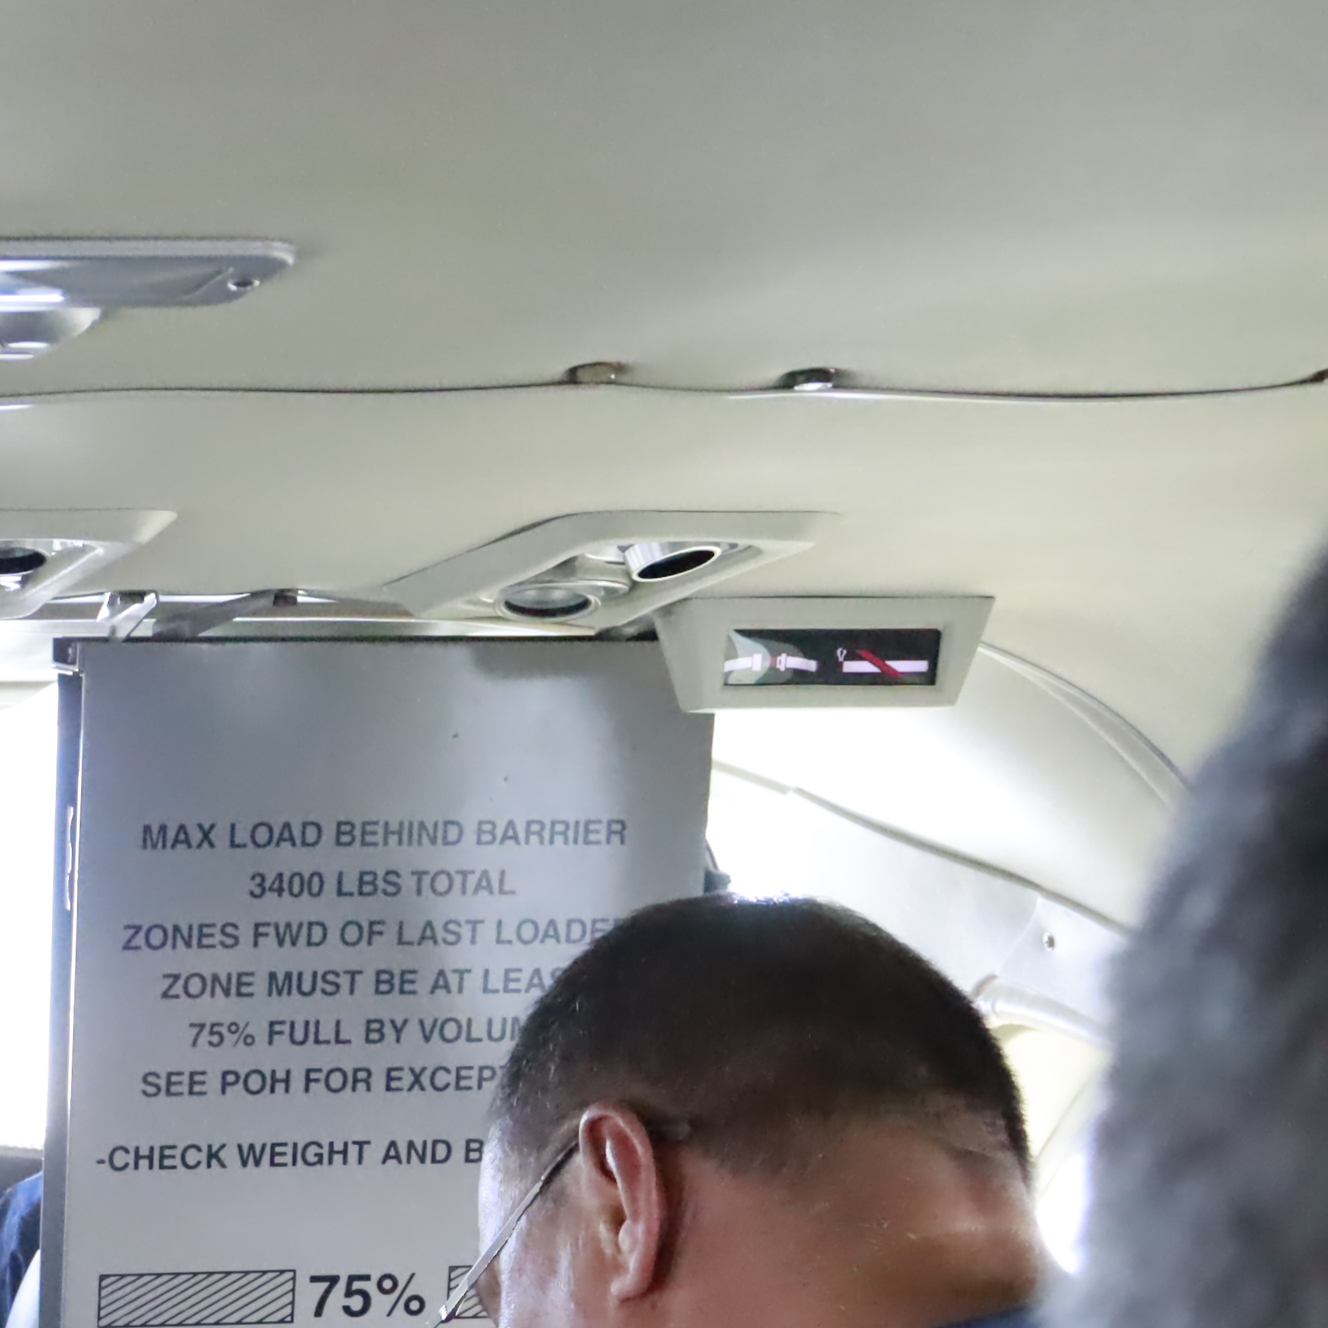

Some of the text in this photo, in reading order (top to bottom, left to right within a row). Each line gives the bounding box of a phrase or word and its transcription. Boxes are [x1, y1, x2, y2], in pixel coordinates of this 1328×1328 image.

[143, 819, 627, 849] MAX LOAD BEHIND BARRIER
[249, 870, 516, 898] 3400 LBS TOTAL
[122, 918, 624, 950] ZONES FWD OF LAST LOADE
[161, 967, 564, 999] ZONE MUST BE AT LEA
[189, 1017, 522, 1047] 75% FULL BY VOLU
[142, 1065, 506, 1097] SEE POH FOR EXCEP
[97, 1144, 226, 1171] -CHECK
[237, 1141, 371, 1168] WEIGHT
[382, 1139, 452, 1164] AND
[310, 1273, 425, 1317] 75%
